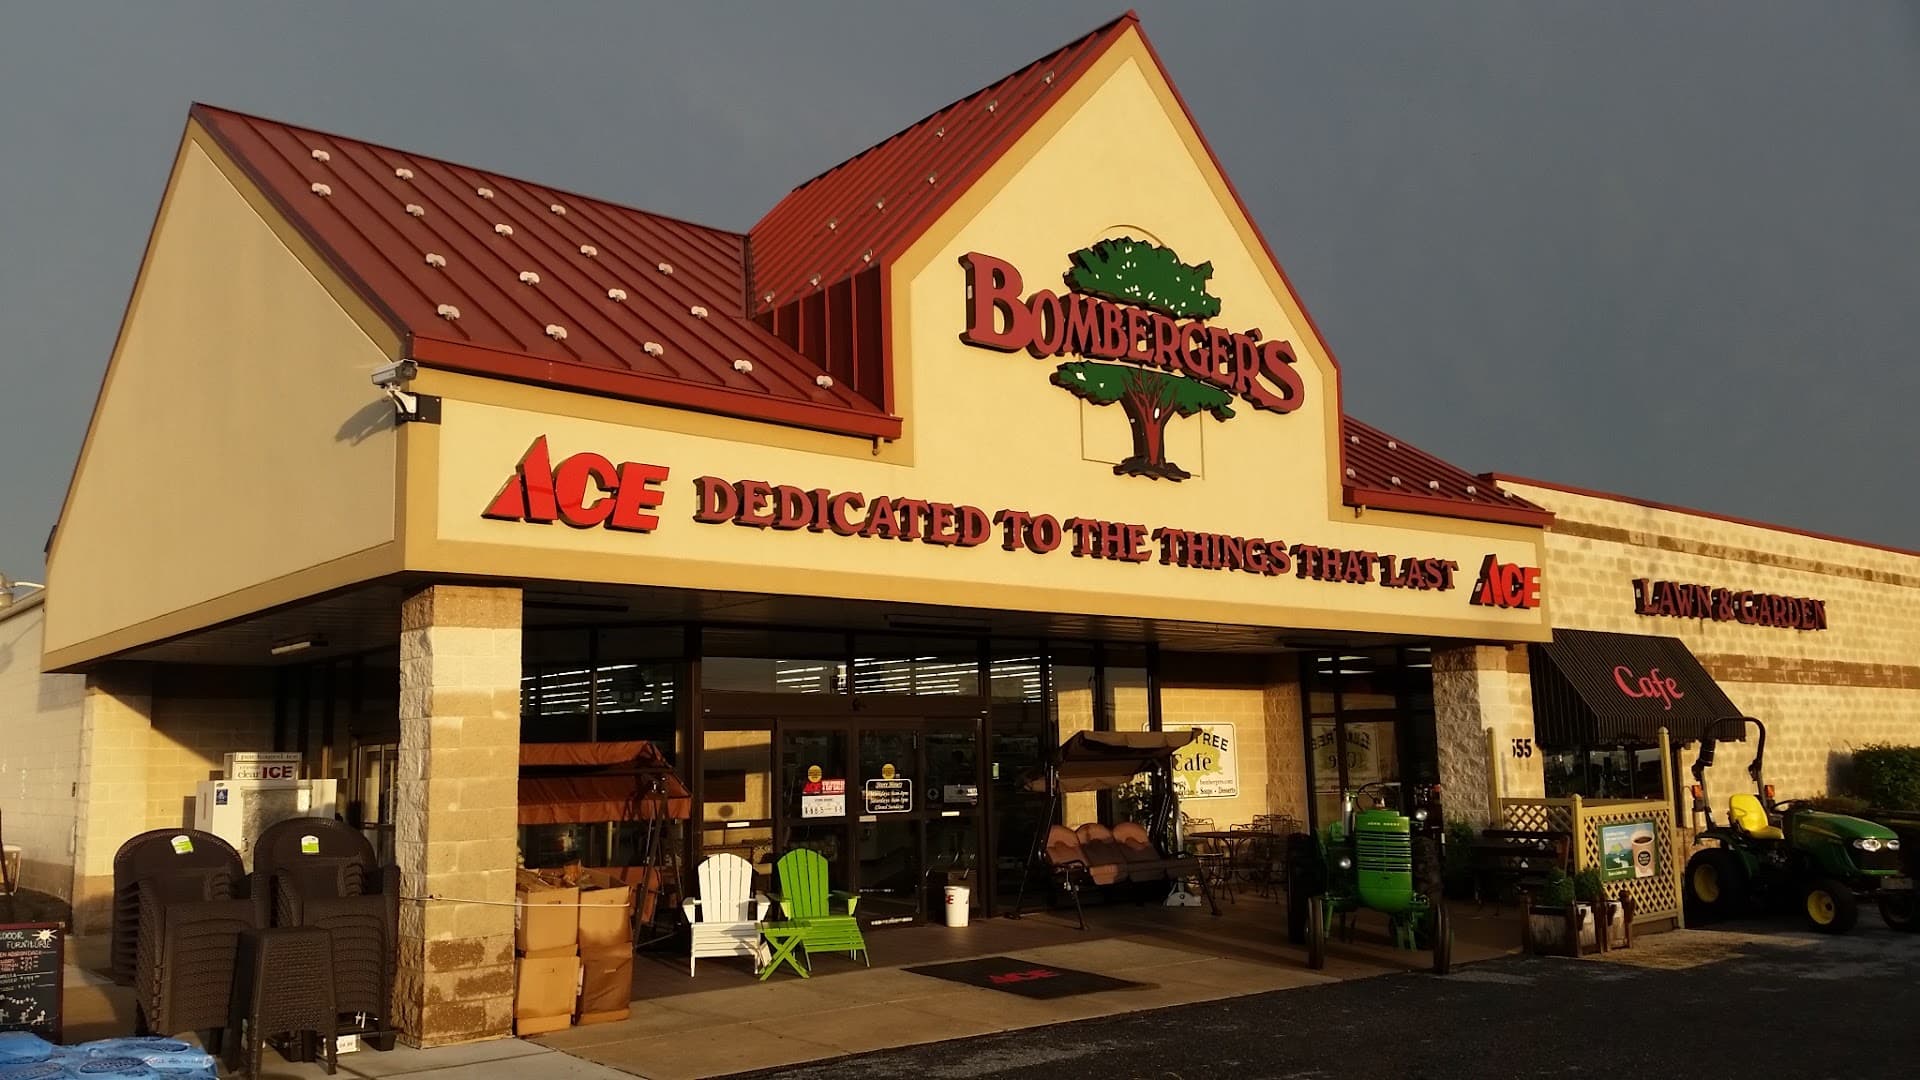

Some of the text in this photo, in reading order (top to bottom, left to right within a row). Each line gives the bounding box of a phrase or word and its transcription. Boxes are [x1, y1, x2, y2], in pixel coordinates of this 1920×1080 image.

[959, 251, 1305, 413] BOMBERGER'S
[481, 434, 669, 534] ACE
[693, 476, 1459, 591] DEDICATED TO THE THINGS THAT LAST
[1470, 554, 1541, 608] ACE
[1632, 578, 1827, 631] LAWN & GARDEN
[1613, 666, 1684, 710] Cafe
[262, 765, 293, 778] ICE
